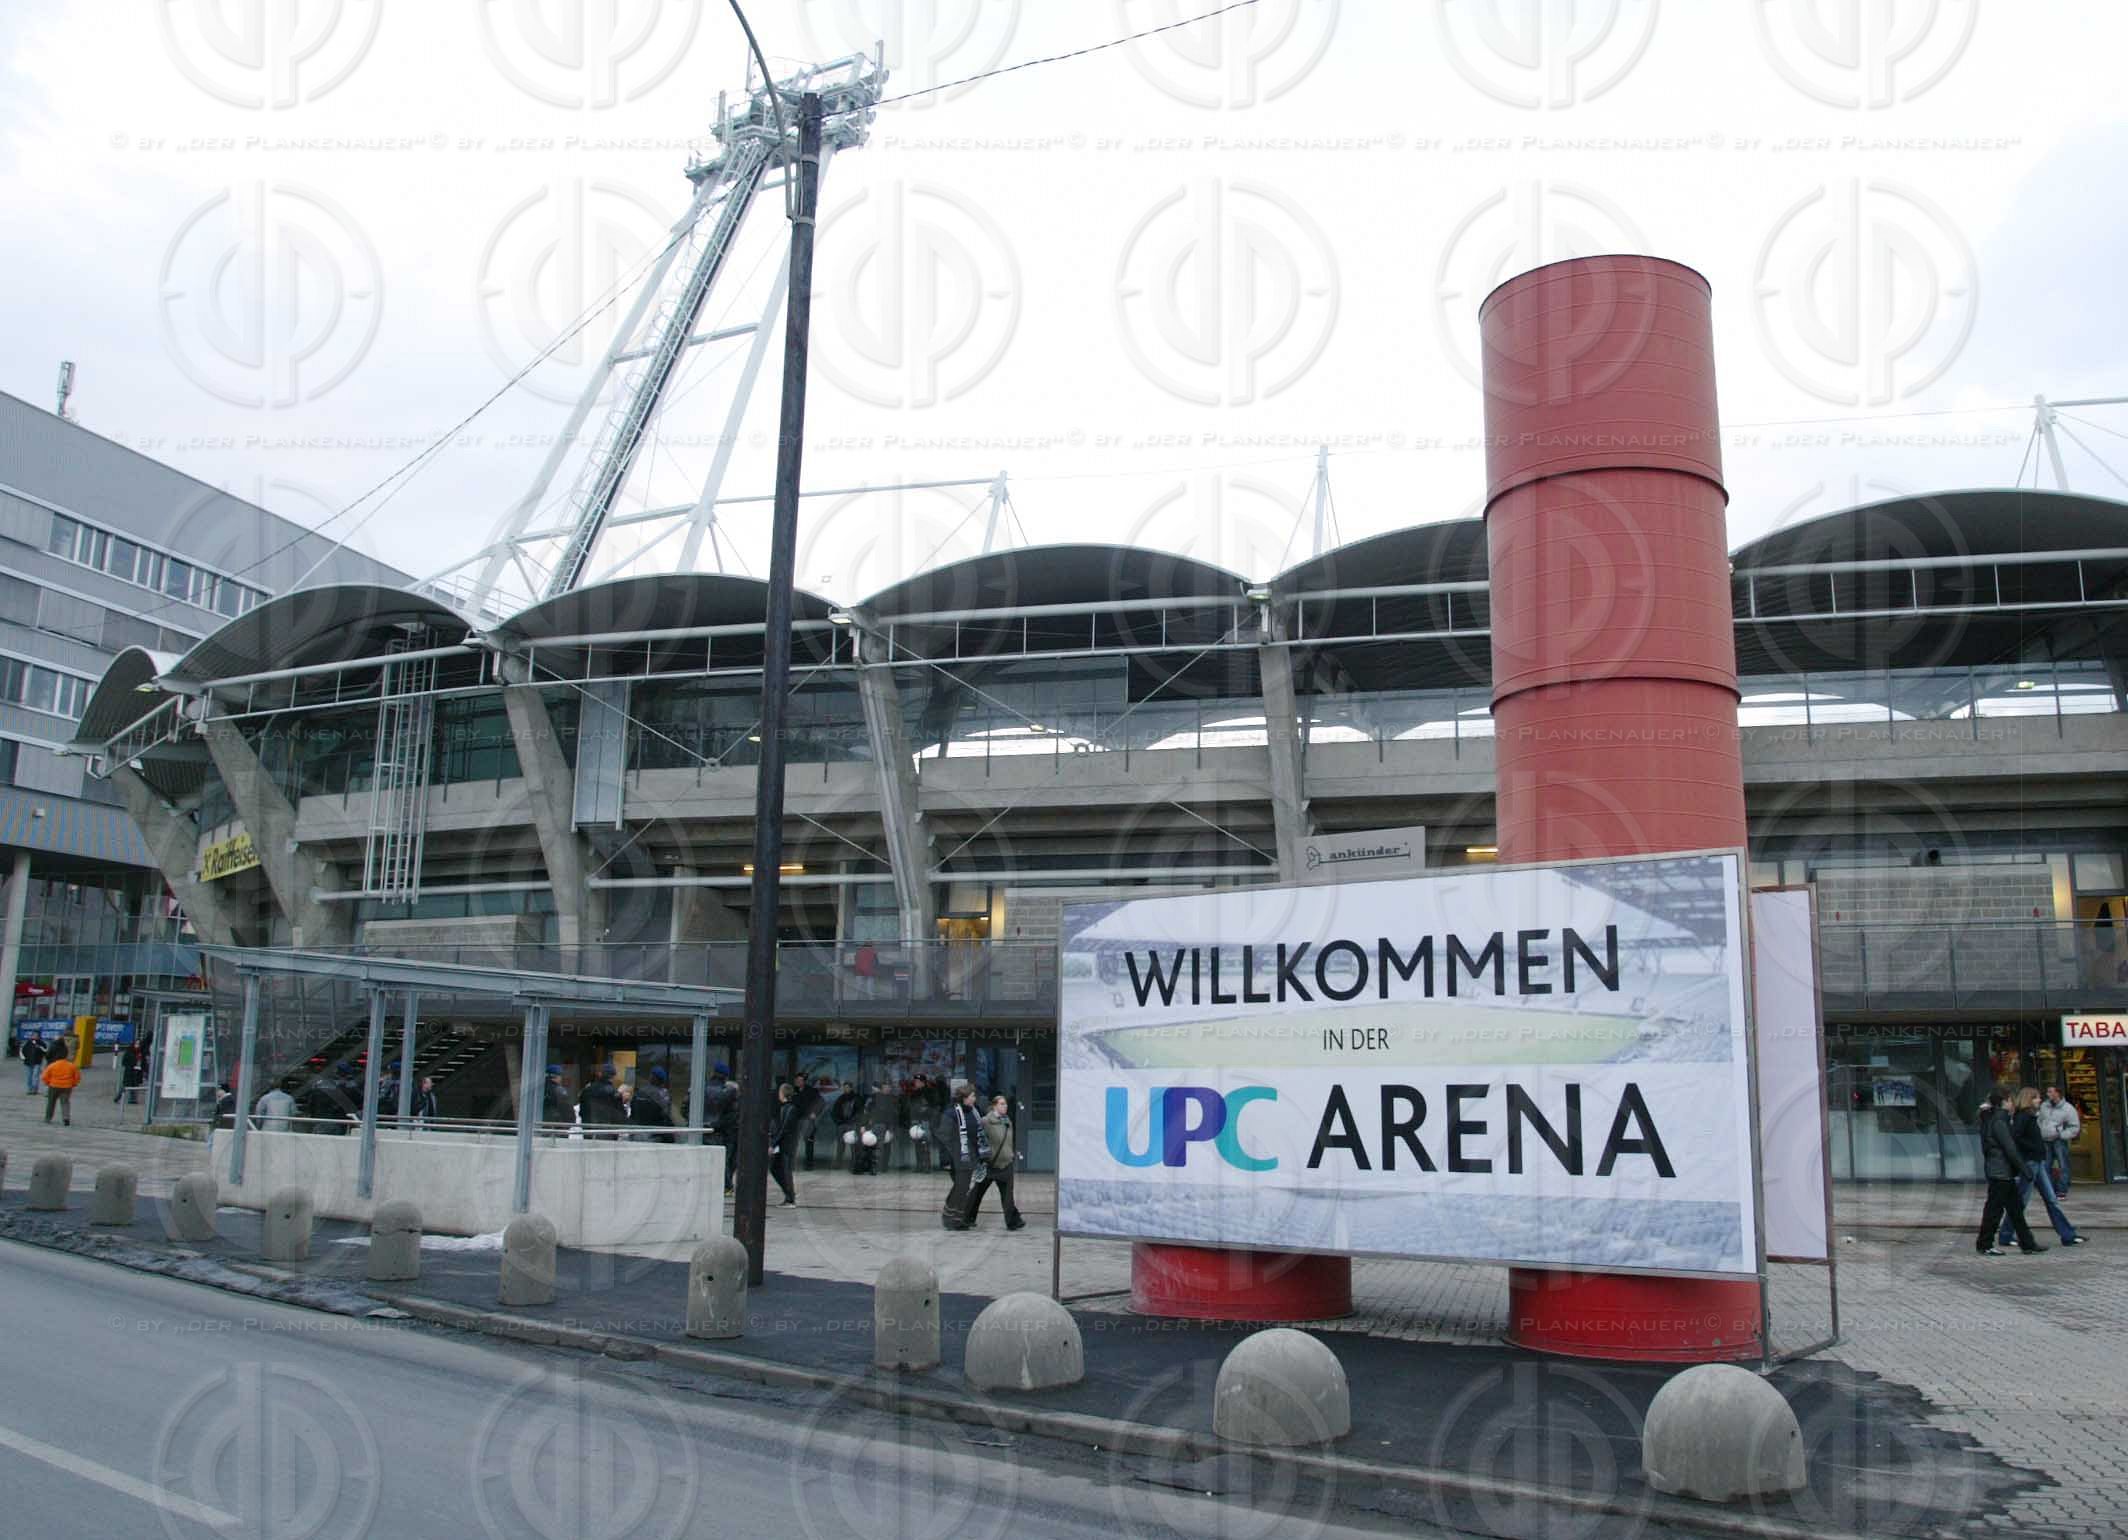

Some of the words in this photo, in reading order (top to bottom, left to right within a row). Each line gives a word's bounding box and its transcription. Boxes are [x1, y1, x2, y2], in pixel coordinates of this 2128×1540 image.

[1124, 924, 1620, 1007] WILLKOMMEN
[1323, 1029, 1345, 1052] IN
[1351, 1028, 1390, 1051] DER
[1105, 1086, 1279, 1172] UPC
[1306, 1083, 1677, 1179] ARENA
